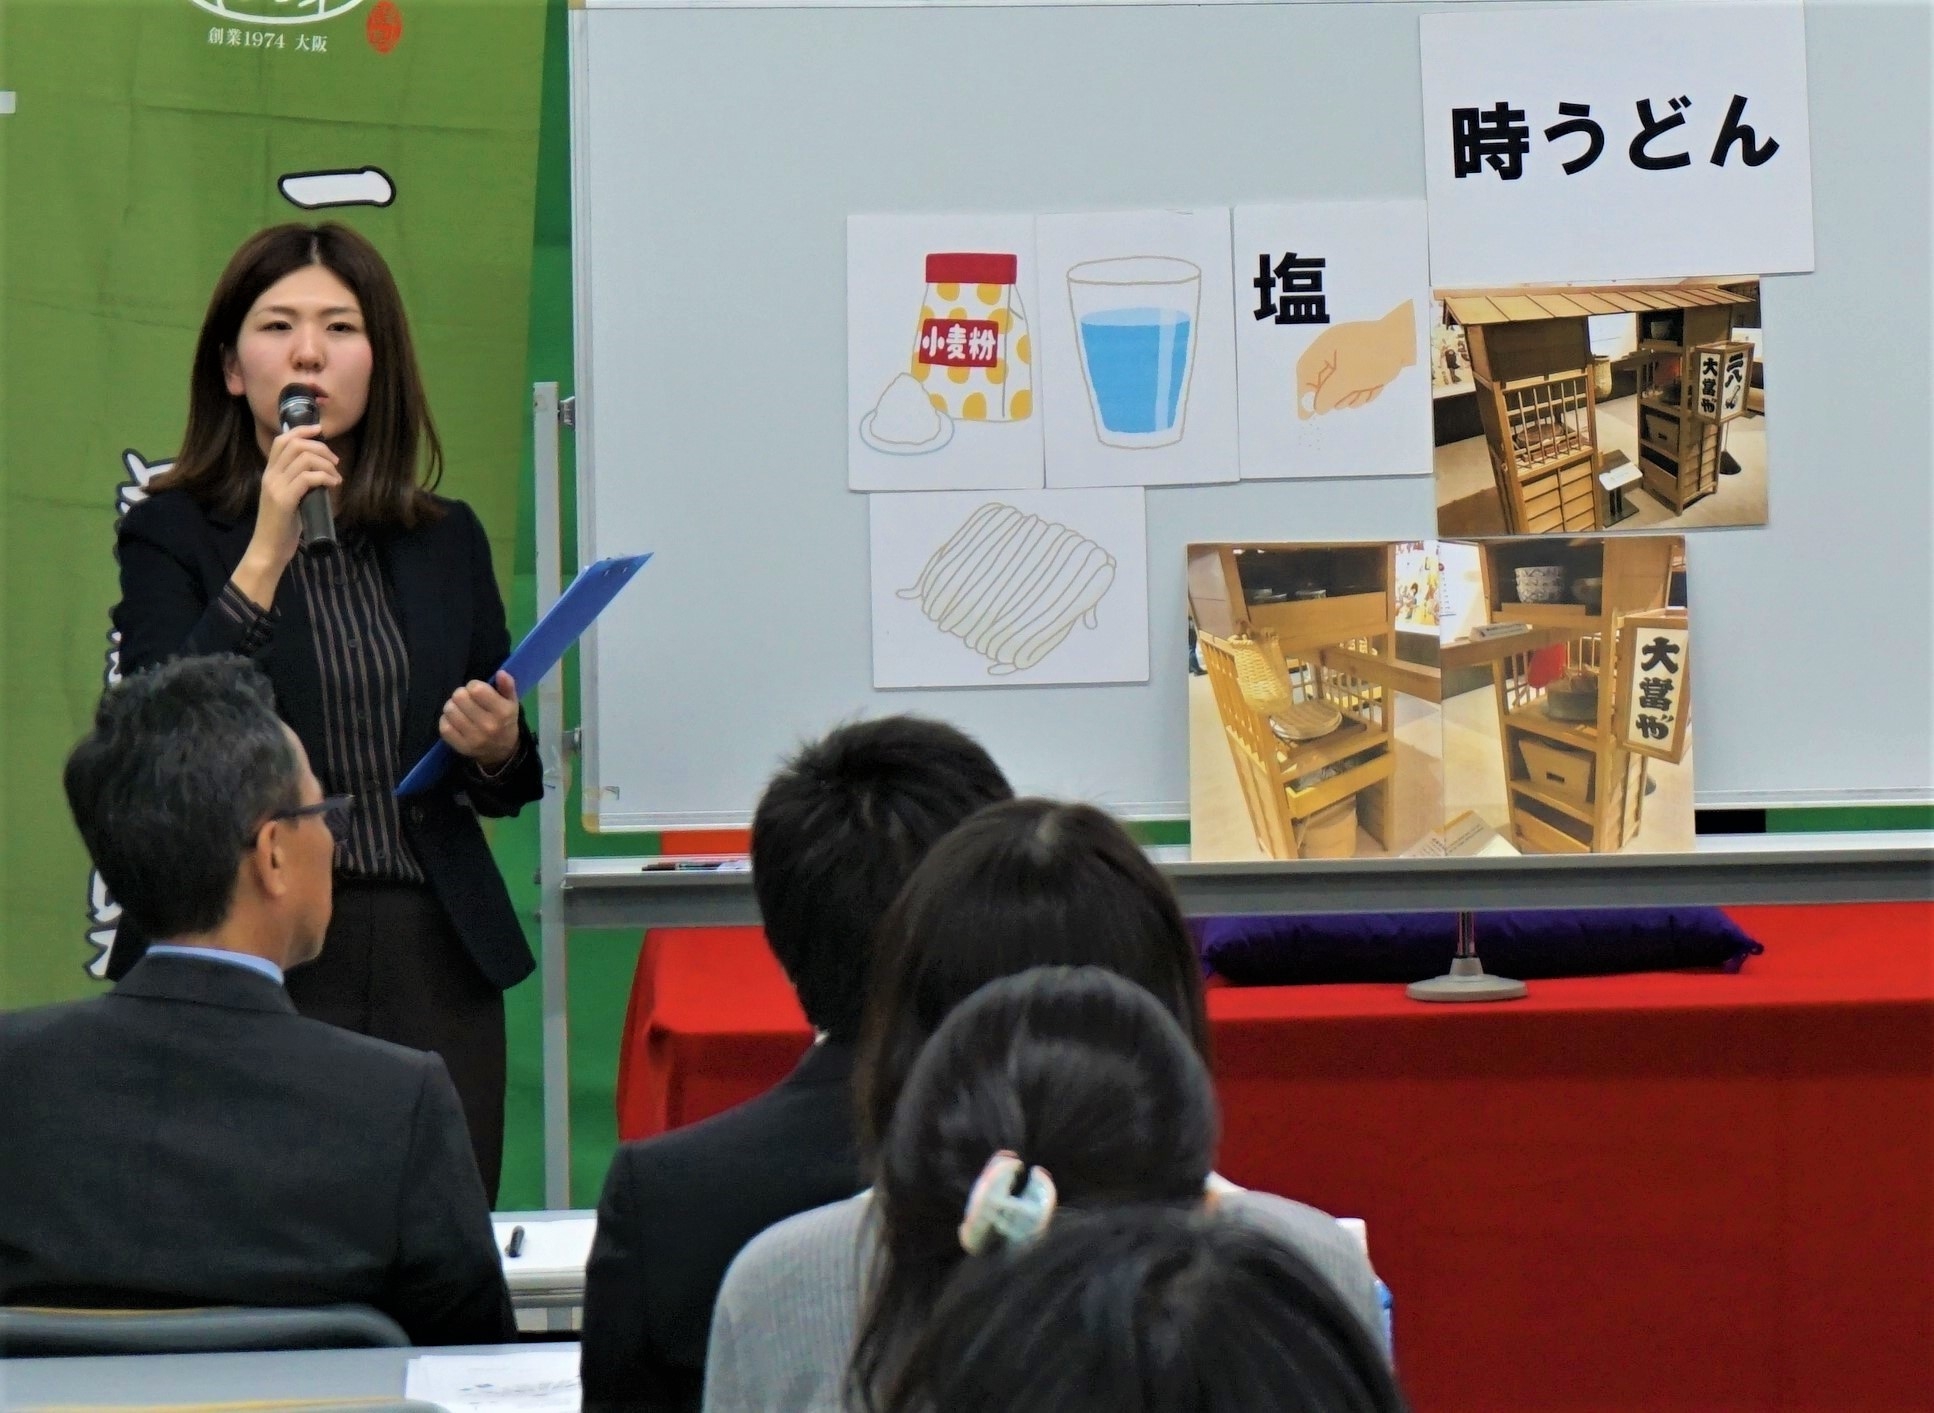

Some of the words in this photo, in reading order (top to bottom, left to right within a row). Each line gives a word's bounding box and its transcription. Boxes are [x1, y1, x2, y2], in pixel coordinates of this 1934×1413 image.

[207, 26, 286, 49] 創業1974
[294, 33, 328, 52] 大阪
[1451, 94, 1781, 180] 時うどん
[1253, 251, 1330, 325] 塩
[922, 322, 997, 361] 小麦粉
